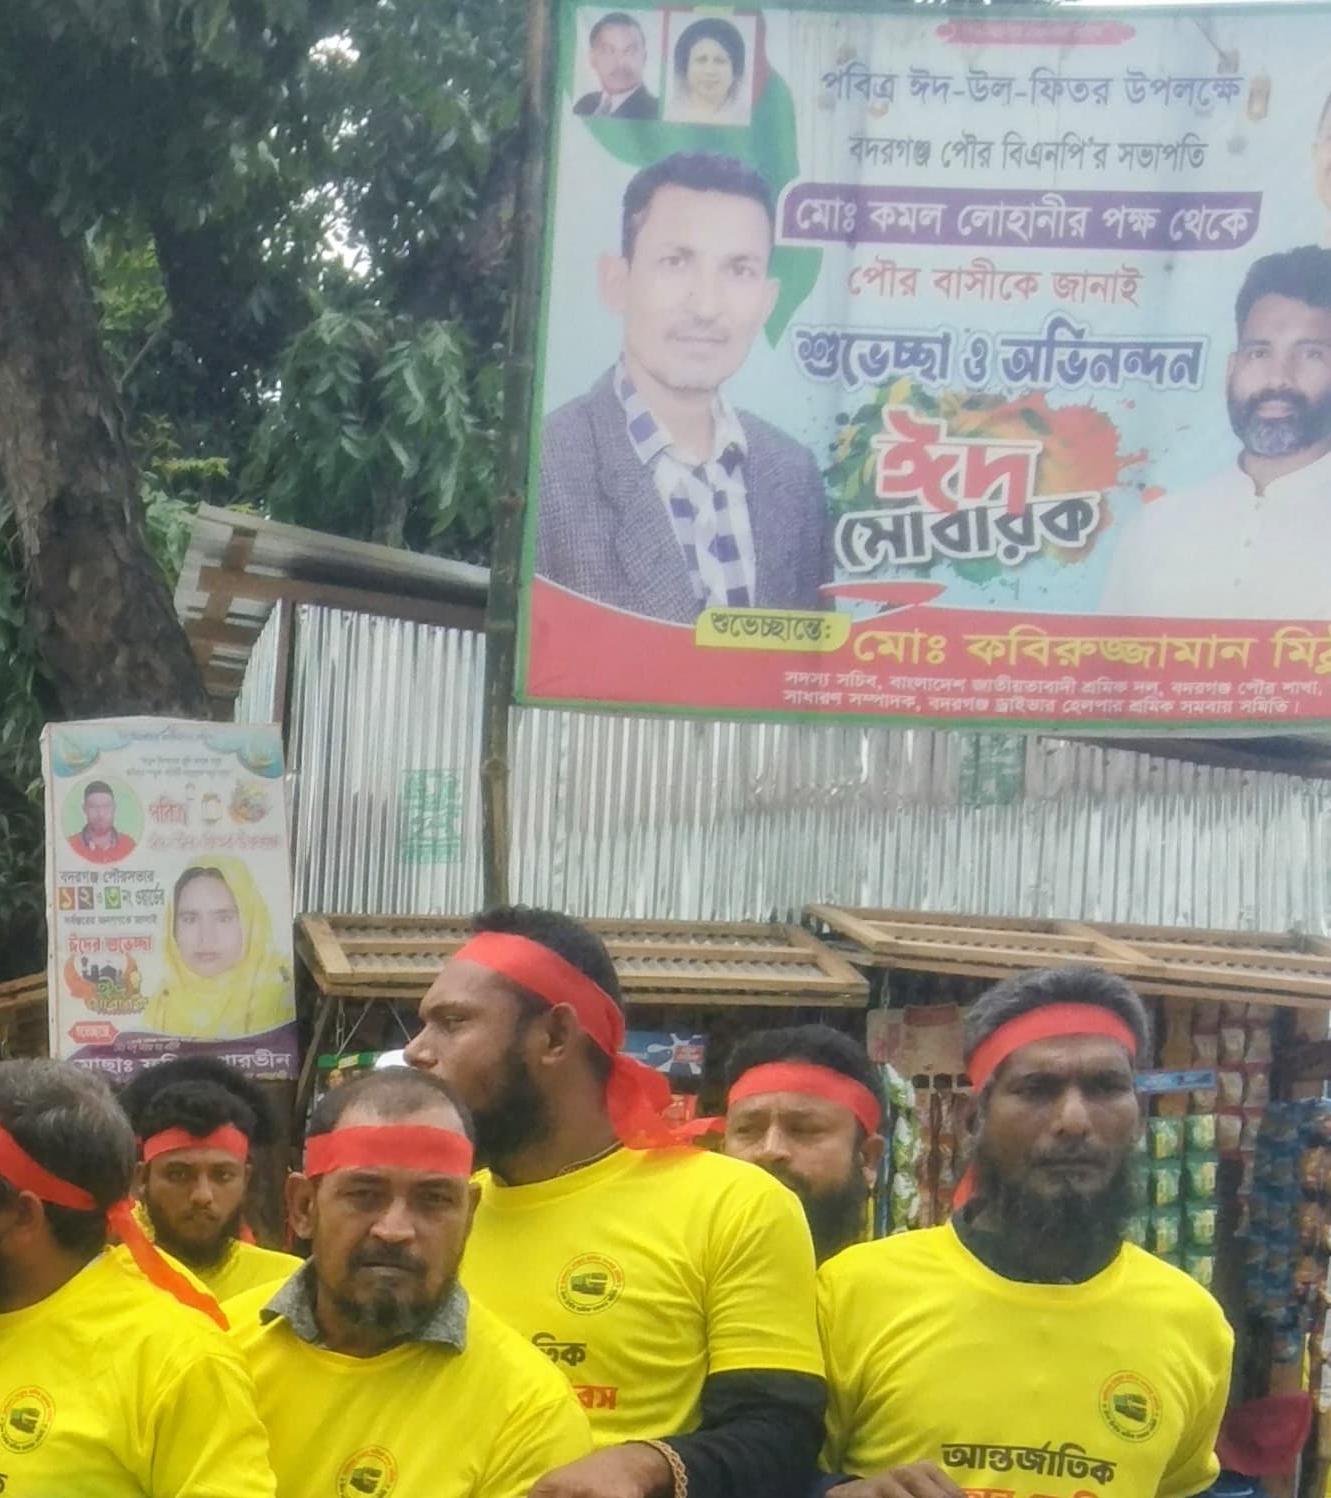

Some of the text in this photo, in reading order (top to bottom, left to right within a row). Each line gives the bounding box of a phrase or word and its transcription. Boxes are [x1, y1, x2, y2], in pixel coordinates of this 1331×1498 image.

[822, 62, 1243, 107] পবিত্র ঈদ-উল-ফিতর উপলক্ষে
[849, 136, 931, 167] বদরগঞ্জ
[942, 130, 993, 169] পৌর
[1118, 133, 1208, 171] সভাপতি
[796, 193, 1252, 241] মোঃ কমল লোহানীর পক্ষ থেকে
[848, 255, 1144, 306] পৌর বাসীকে জানাই
[796, 316, 1204, 387] শুভেচ্ছা ও অভিনন্দন
[873, 405, 1041, 516] ঈদ
[839, 495, 1100, 571] মোবারক
[854, 628, 946, 664] মোঃ
[963, 624, 1257, 669] কবিরুজ্জামান
[941, 1441, 1117, 1485] আন্তর্জাতিক
